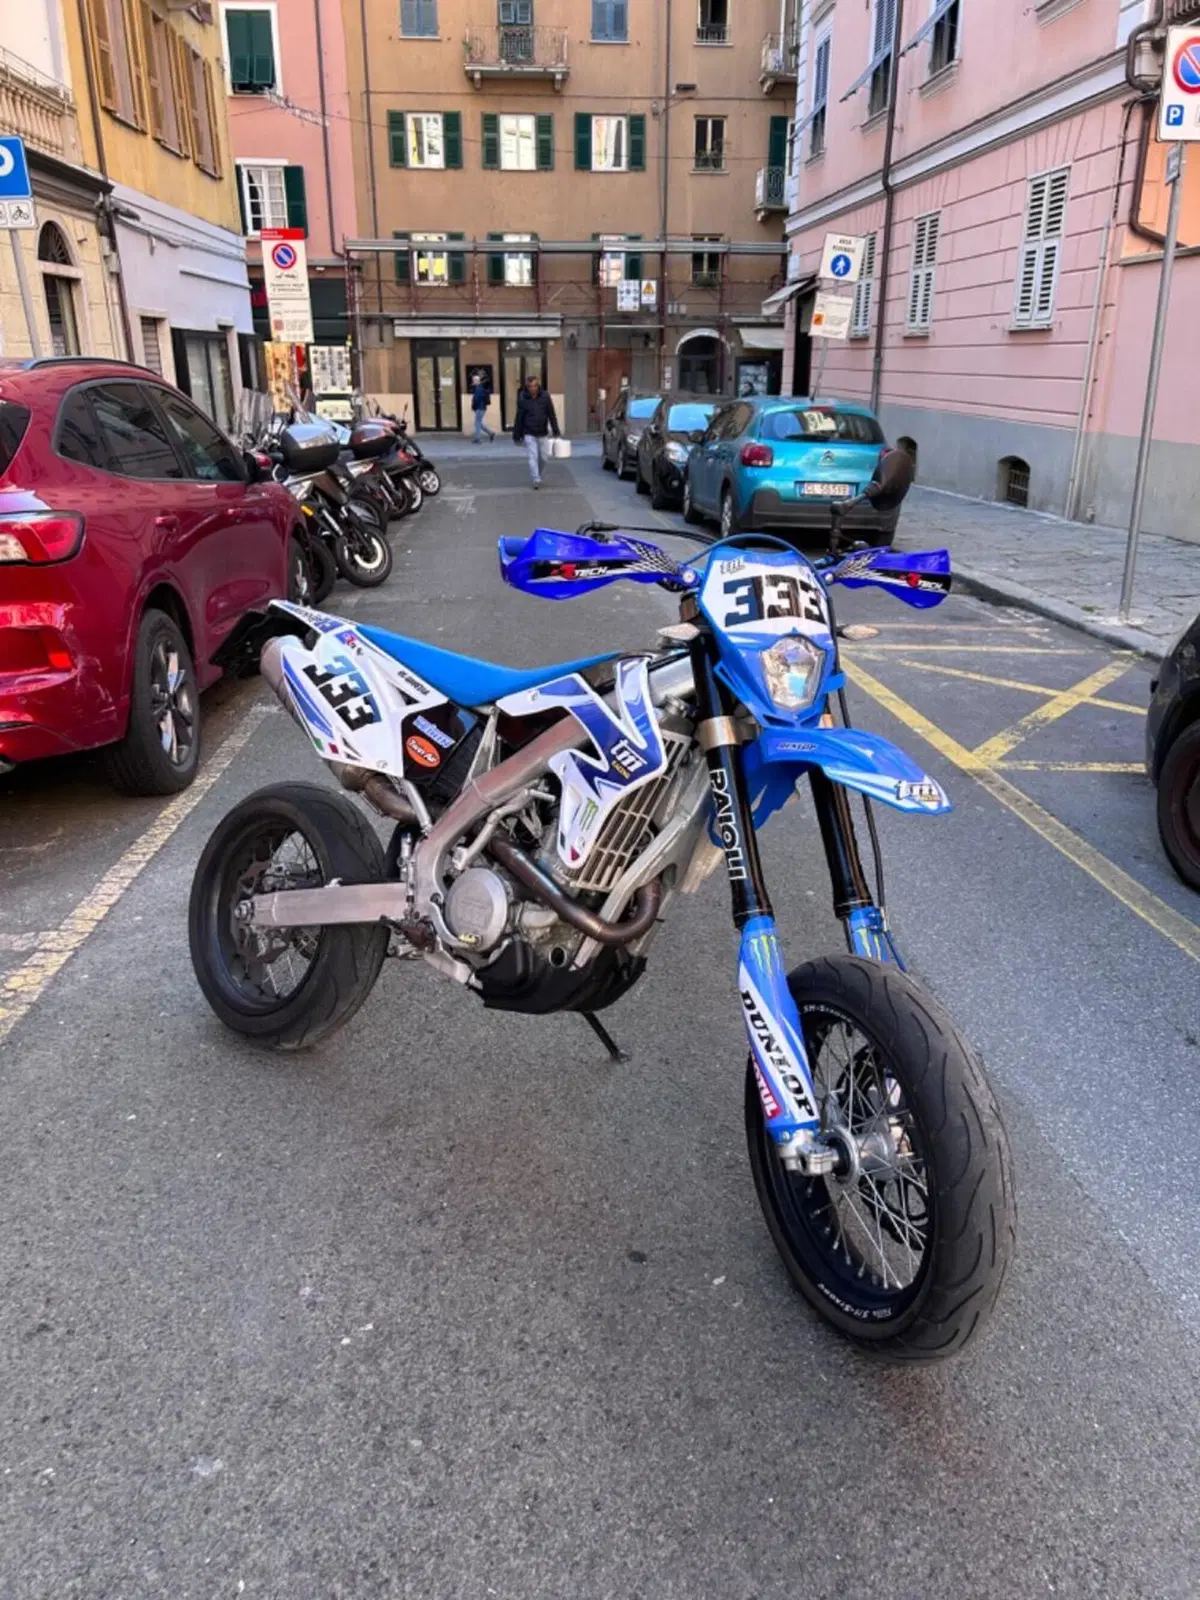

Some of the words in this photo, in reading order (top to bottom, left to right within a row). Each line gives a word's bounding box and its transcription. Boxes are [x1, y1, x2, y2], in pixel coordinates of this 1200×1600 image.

[1169, 108, 1181, 124] P
[723, 574, 828, 628] 333
[302, 655, 383, 732] 333
[709, 768, 747, 880] PAIOLI
[741, 990, 815, 1117] DUNLOP
